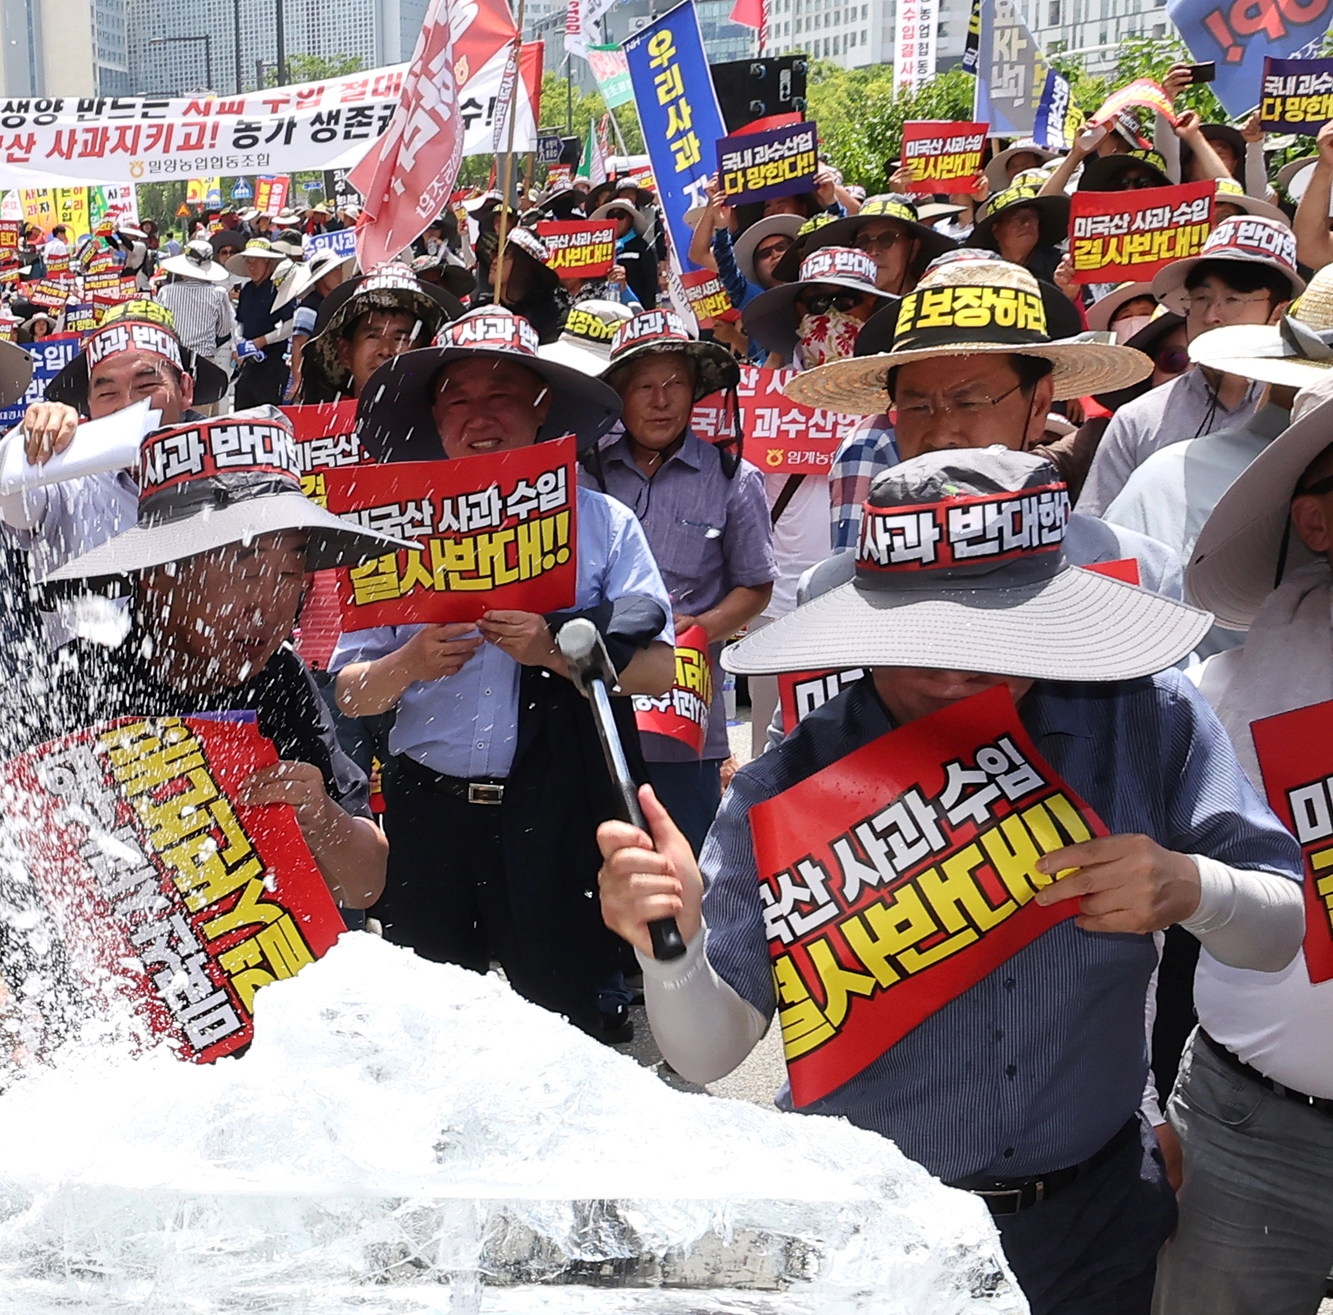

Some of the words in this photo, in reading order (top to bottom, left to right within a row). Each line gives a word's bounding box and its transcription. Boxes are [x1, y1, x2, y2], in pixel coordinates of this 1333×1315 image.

[1261, 97, 1283, 122] 다
[231, 117, 299, 151] 농가
[721, 148, 754, 172] 국내
[753, 130, 814, 161] 과수산업
[905, 138, 944, 158] 미국산
[943, 135, 965, 154] 사과
[964, 133, 984, 153] 수입
[723, 171, 747, 196] 다
[746, 150, 816, 192] 망한다!!
[1073, 214, 1132, 238] 미국산
[1131, 207, 1172, 232] 사과
[1171, 196, 1211, 226] 수입
[457, 317, 516, 344] 사과
[621, 314, 667, 341] 사과
[139, 426, 207, 488] 사과
[438, 484, 504, 533] 사과
[505, 466, 568, 521] 수입
[348, 509, 571, 606] 결사반대!!
[862, 510, 943, 568] 사과
[833, 791, 941, 903] 사과
[938, 737, 1045, 828] 수입
